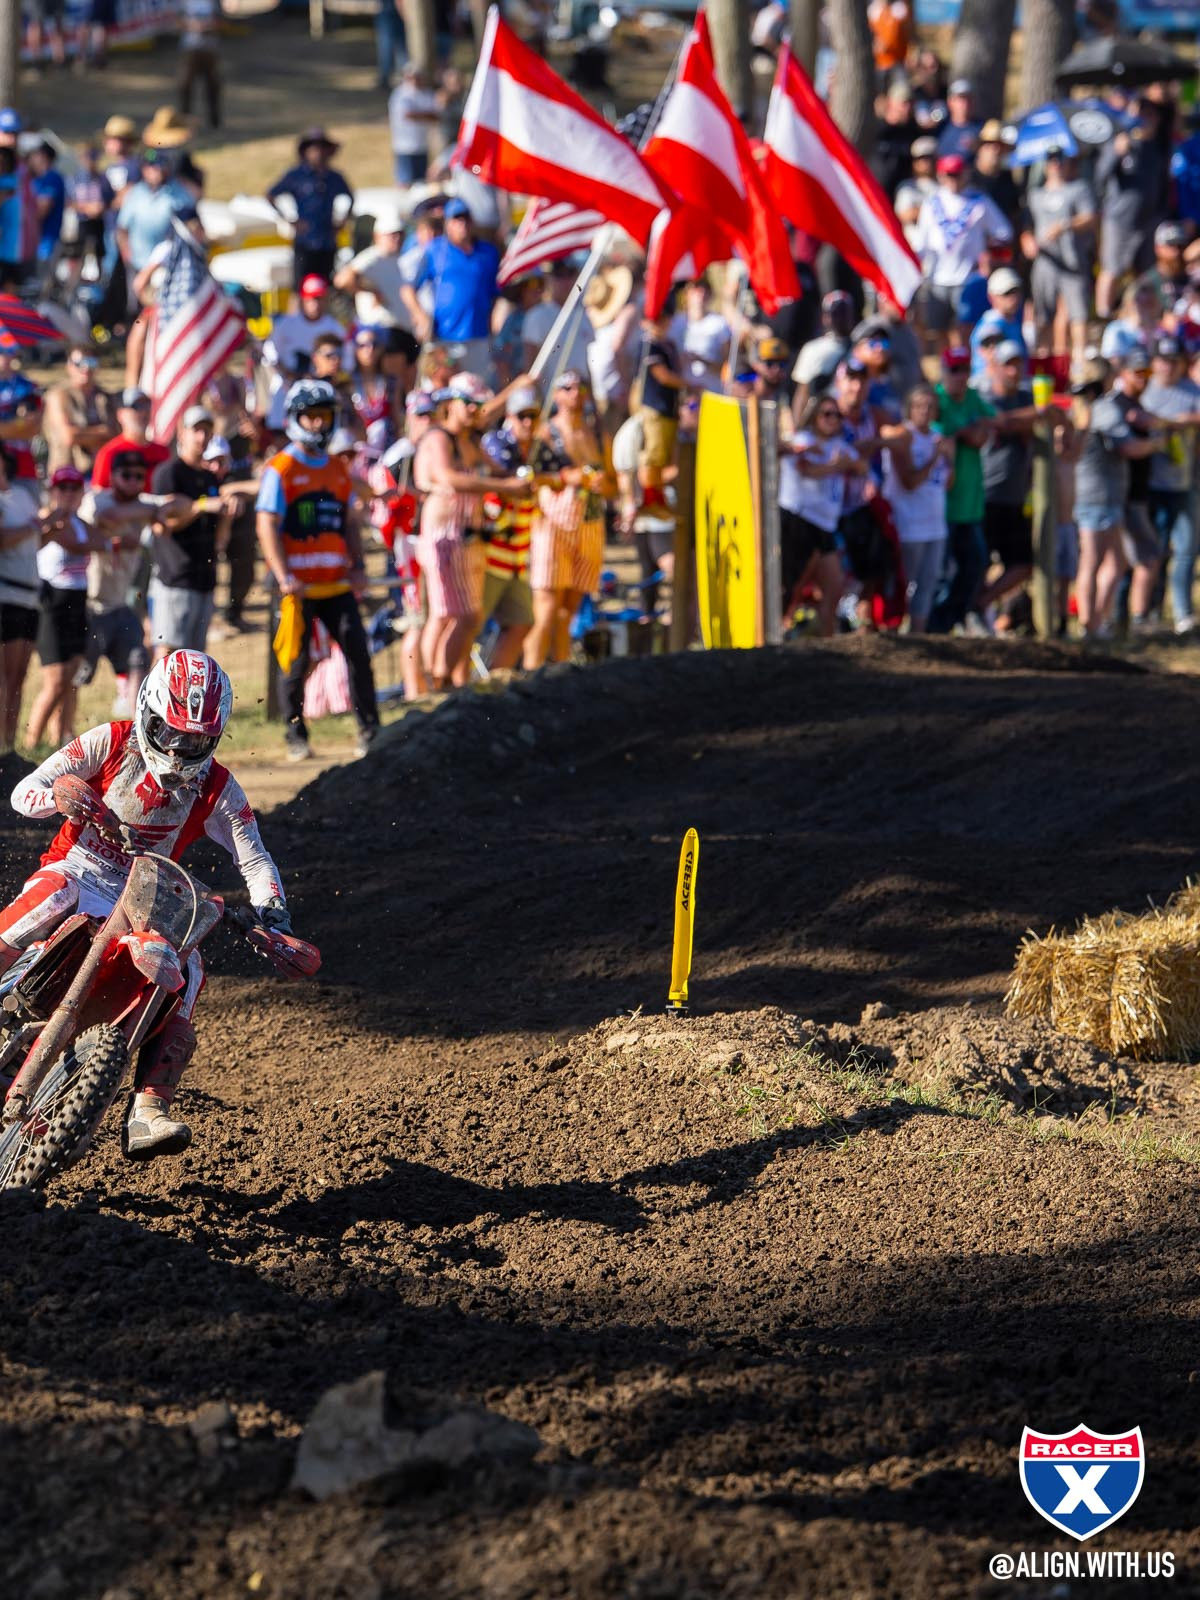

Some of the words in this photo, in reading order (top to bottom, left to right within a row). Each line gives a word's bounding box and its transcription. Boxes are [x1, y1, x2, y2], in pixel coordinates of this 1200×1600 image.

[191, 675, 204, 687] 81
[86, 839, 132, 868] HON
[682, 851, 693, 911] ACERBIS
